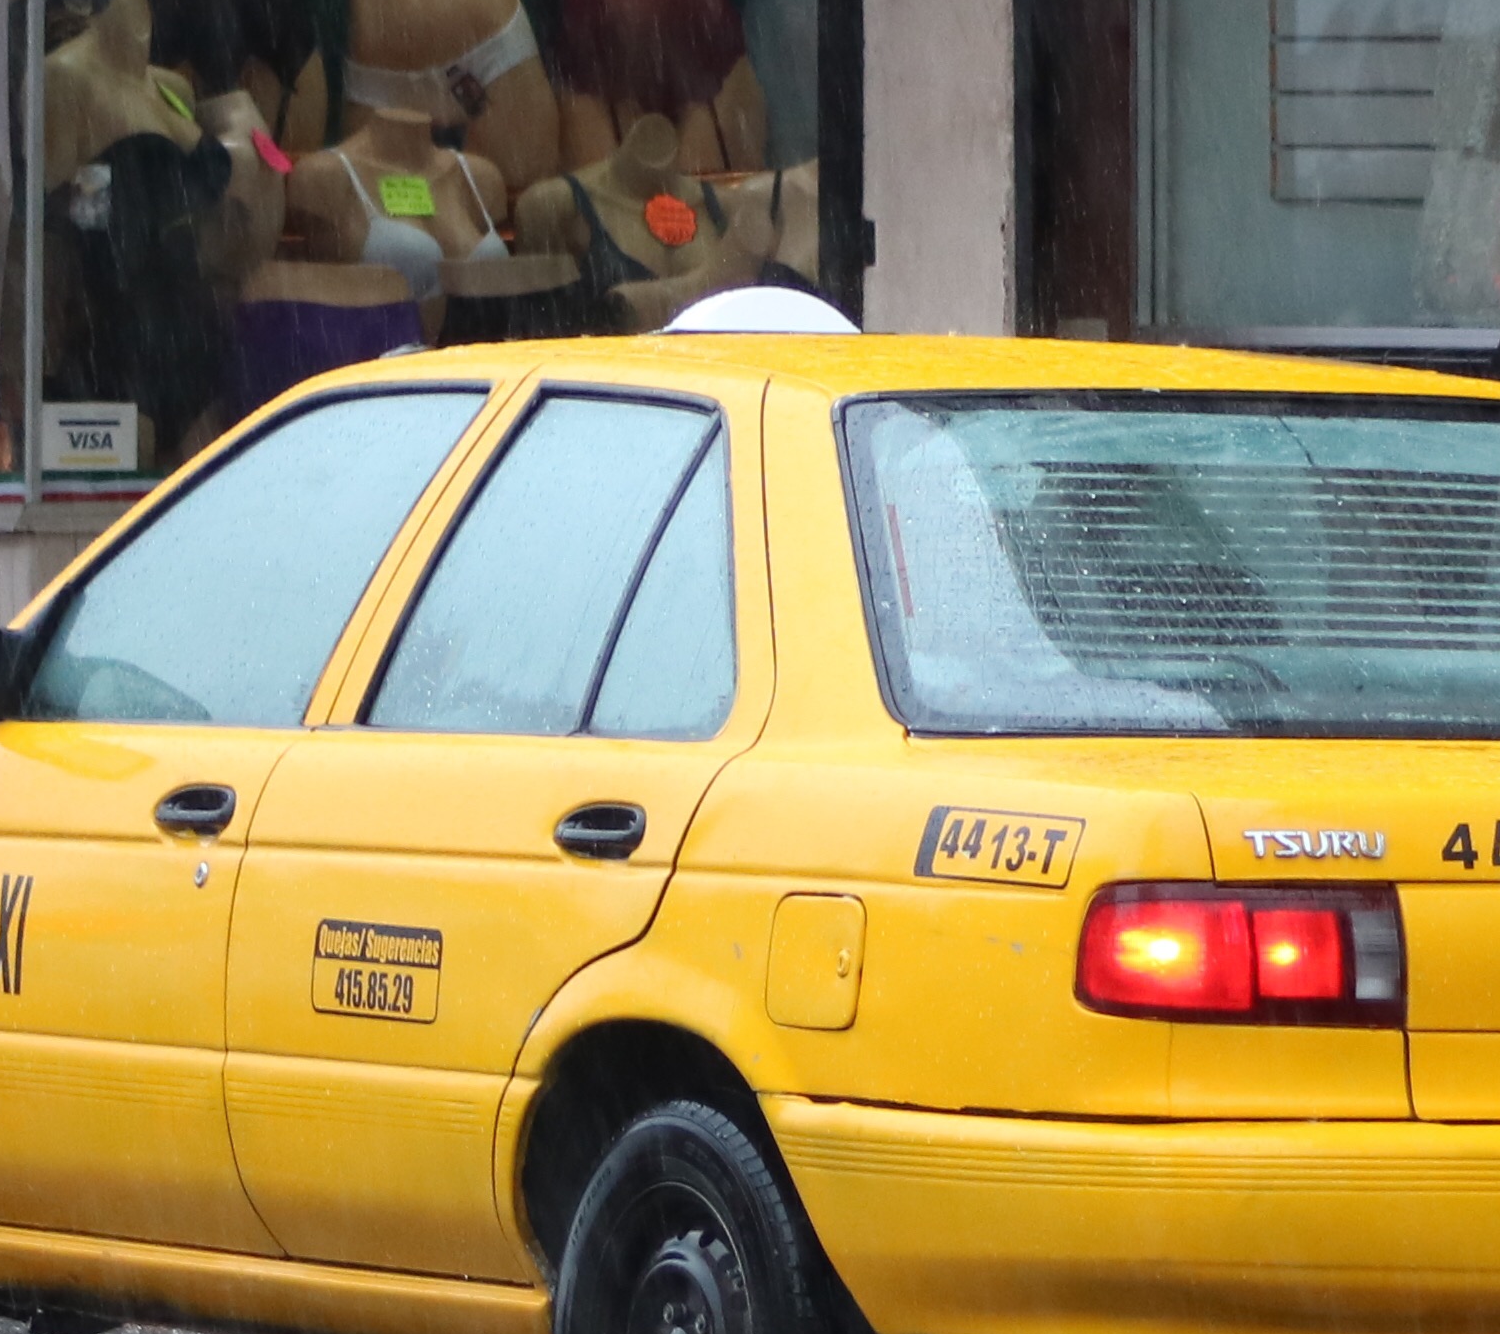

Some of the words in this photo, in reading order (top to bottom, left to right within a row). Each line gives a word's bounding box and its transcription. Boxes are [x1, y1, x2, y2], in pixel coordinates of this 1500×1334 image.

[69, 432, 114, 450] VISA
[939, 819, 1068, 875] 4413-T
[1243, 829, 1386, 859] TSURU
[334, 967, 414, 1014] 415.85.29
